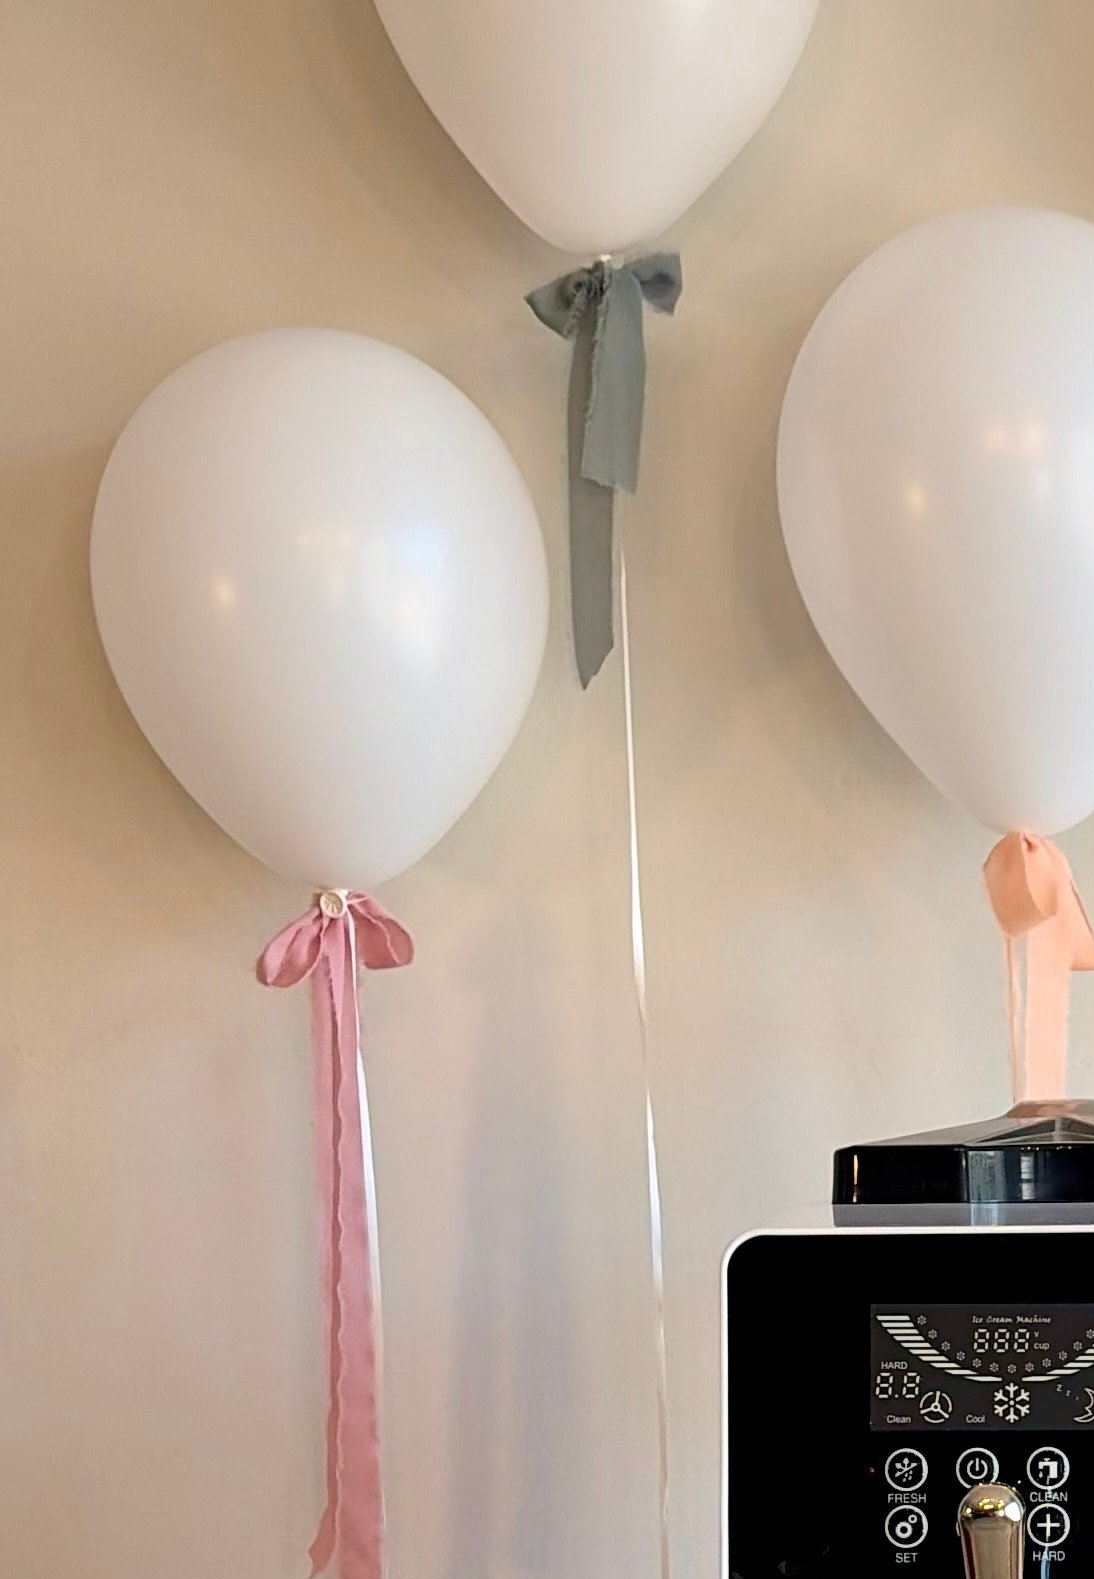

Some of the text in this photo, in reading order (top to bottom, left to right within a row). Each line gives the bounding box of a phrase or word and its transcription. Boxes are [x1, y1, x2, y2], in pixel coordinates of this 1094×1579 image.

[971, 1314, 1052, 1323] Ice Cream Machine
[1033, 1343, 1051, 1351] cup
[880, 1361, 908, 1370] HARD
[885, 1414, 911, 1424] Clean
[965, 1414, 986, 1424] Cool
[887, 1493, 927, 1504] FRESH
[1029, 1491, 1068, 1503] CLEAN
[895, 1552, 918, 1563] SET
[1032, 1550, 1066, 1562] HARD
